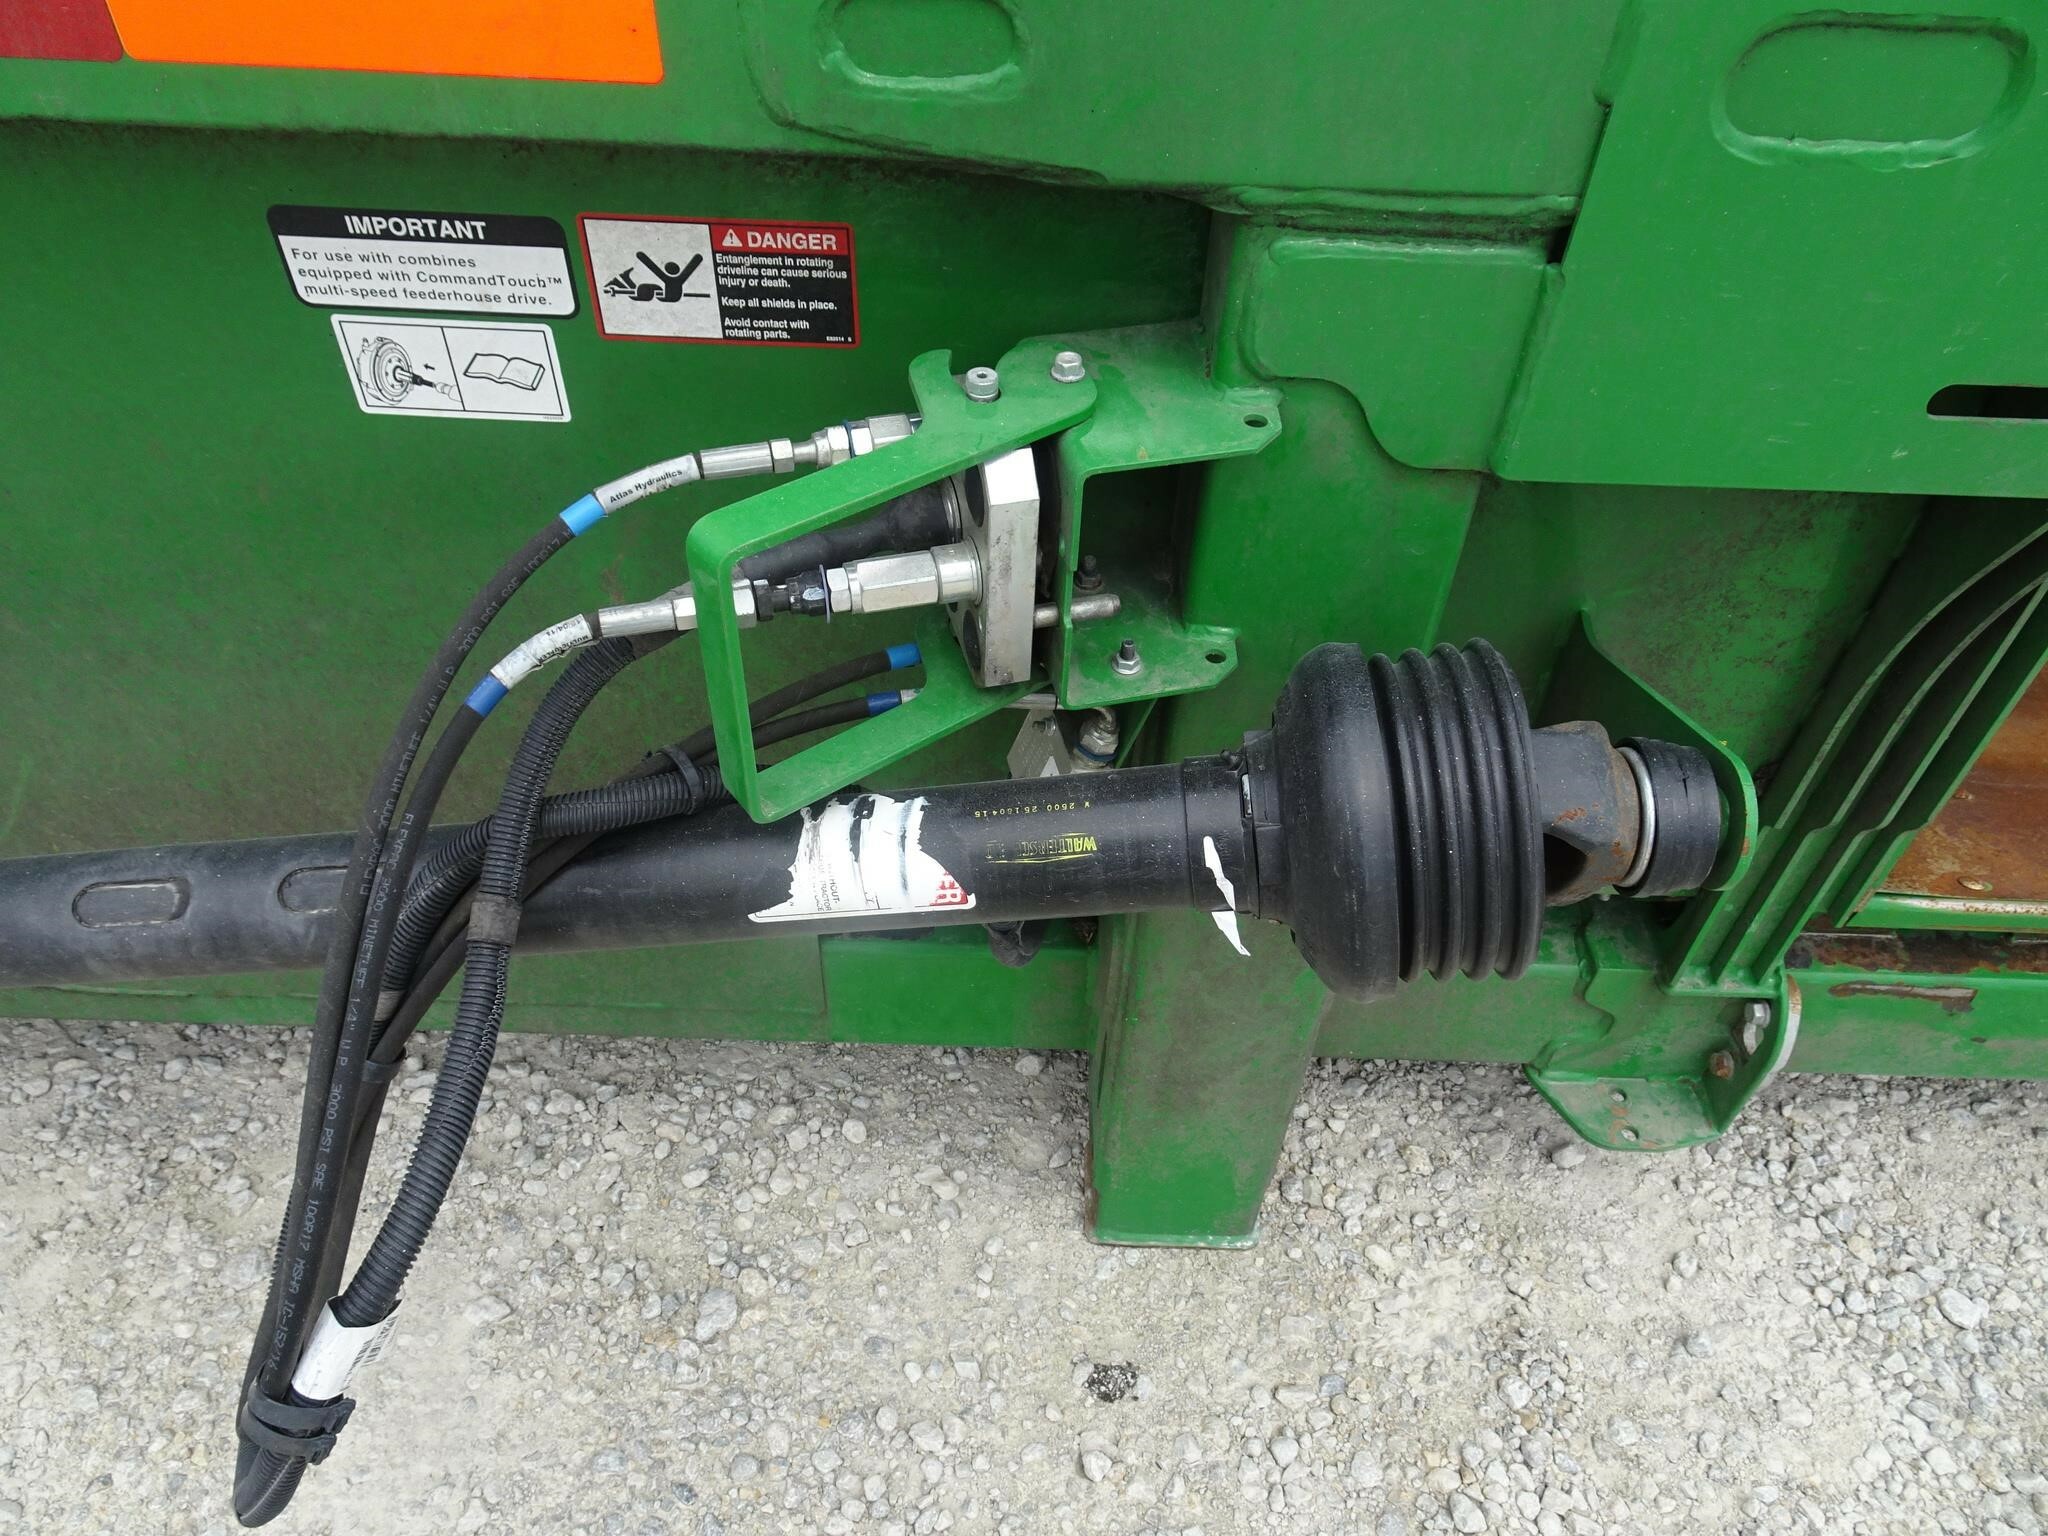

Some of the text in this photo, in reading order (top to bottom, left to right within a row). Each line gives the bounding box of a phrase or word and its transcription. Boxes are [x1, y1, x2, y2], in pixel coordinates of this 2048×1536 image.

[344, 215, 486, 240] IMPORTANT
[747, 232, 837, 250] DANGER
[291, 248, 477, 268] For use with combines
[716, 253, 834, 269] Entanglement in rotating
[298, 266, 372, 284] equipped
[377, 269, 411, 283] with
[717, 265, 848, 279] driveline can cause serious
[719, 277, 791, 288] injury or death.
[305, 283, 552, 306] multi-speed feederhouse drive.
[721, 297, 837, 312] Keep all shields in place.
[724, 317, 809, 329] Avoid contact with
[725, 328, 791, 340] rotating parts.
[609, 488, 634, 504] Atlas
[634, 469, 683, 493] Hydraulics
[985, 836, 1098, 859] WALTERSC
[358, 919, 380, 989] MINETUFF
[326, 1083, 342, 1120] 3000
[320, 1127, 335, 1154] PSI
[312, 1162, 327, 1191] SAE
[298, 1199, 320, 1251] 100R17
